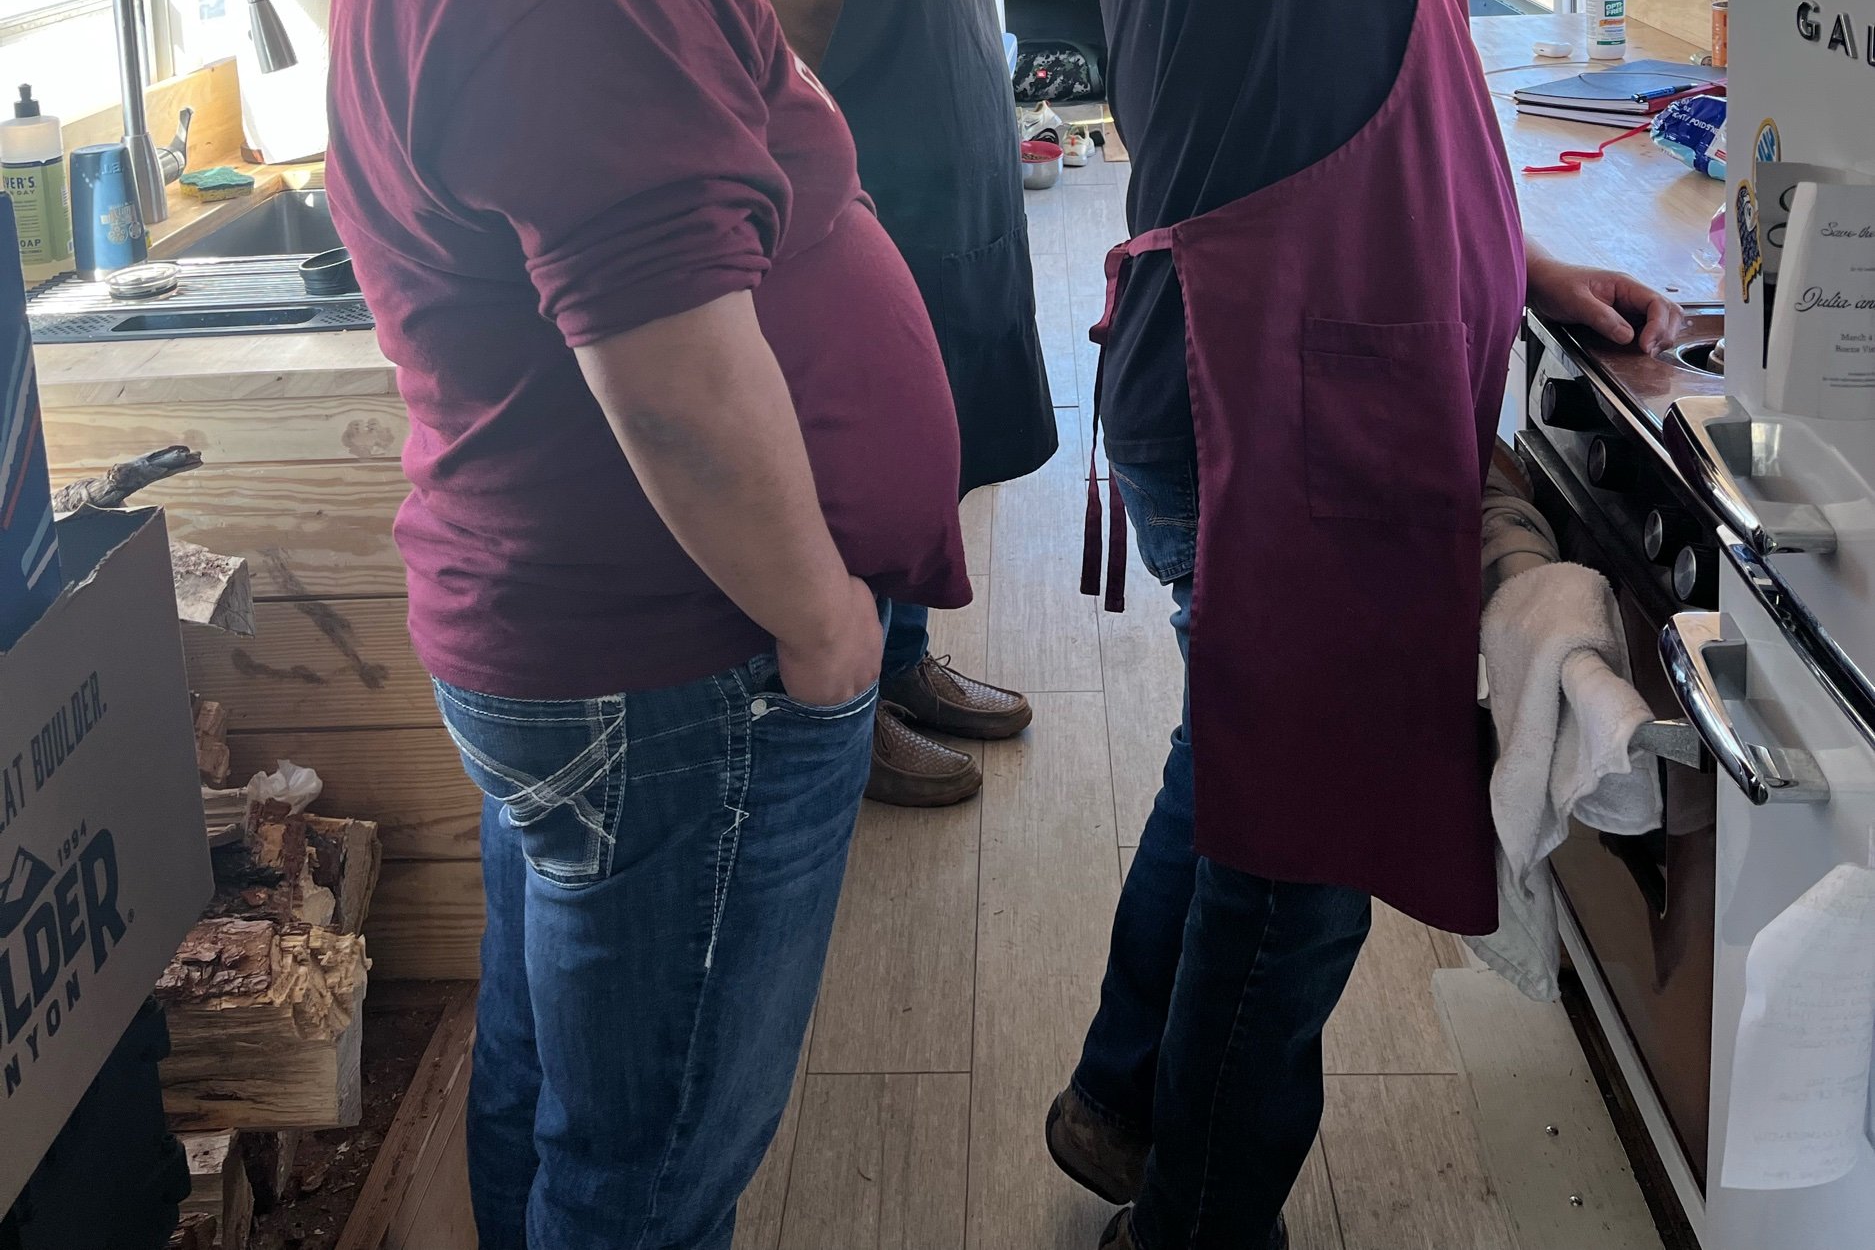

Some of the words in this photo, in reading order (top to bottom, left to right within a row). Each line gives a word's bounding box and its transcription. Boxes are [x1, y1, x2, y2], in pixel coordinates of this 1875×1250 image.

[3, 176, 35, 189] YER'S
[20, 238, 42, 248] OAP
[1821, 221, 1856, 237] Save
[1794, 286, 1851, 312] Julia
[1855, 297, 1875, 309] an
[0, 753, 23, 831] AT
[30, 670, 107, 792] BOULDER.
[56, 817, 87, 868] 1994
[0, 828, 127, 1046] LDER
[3, 968, 82, 1099] NYON
